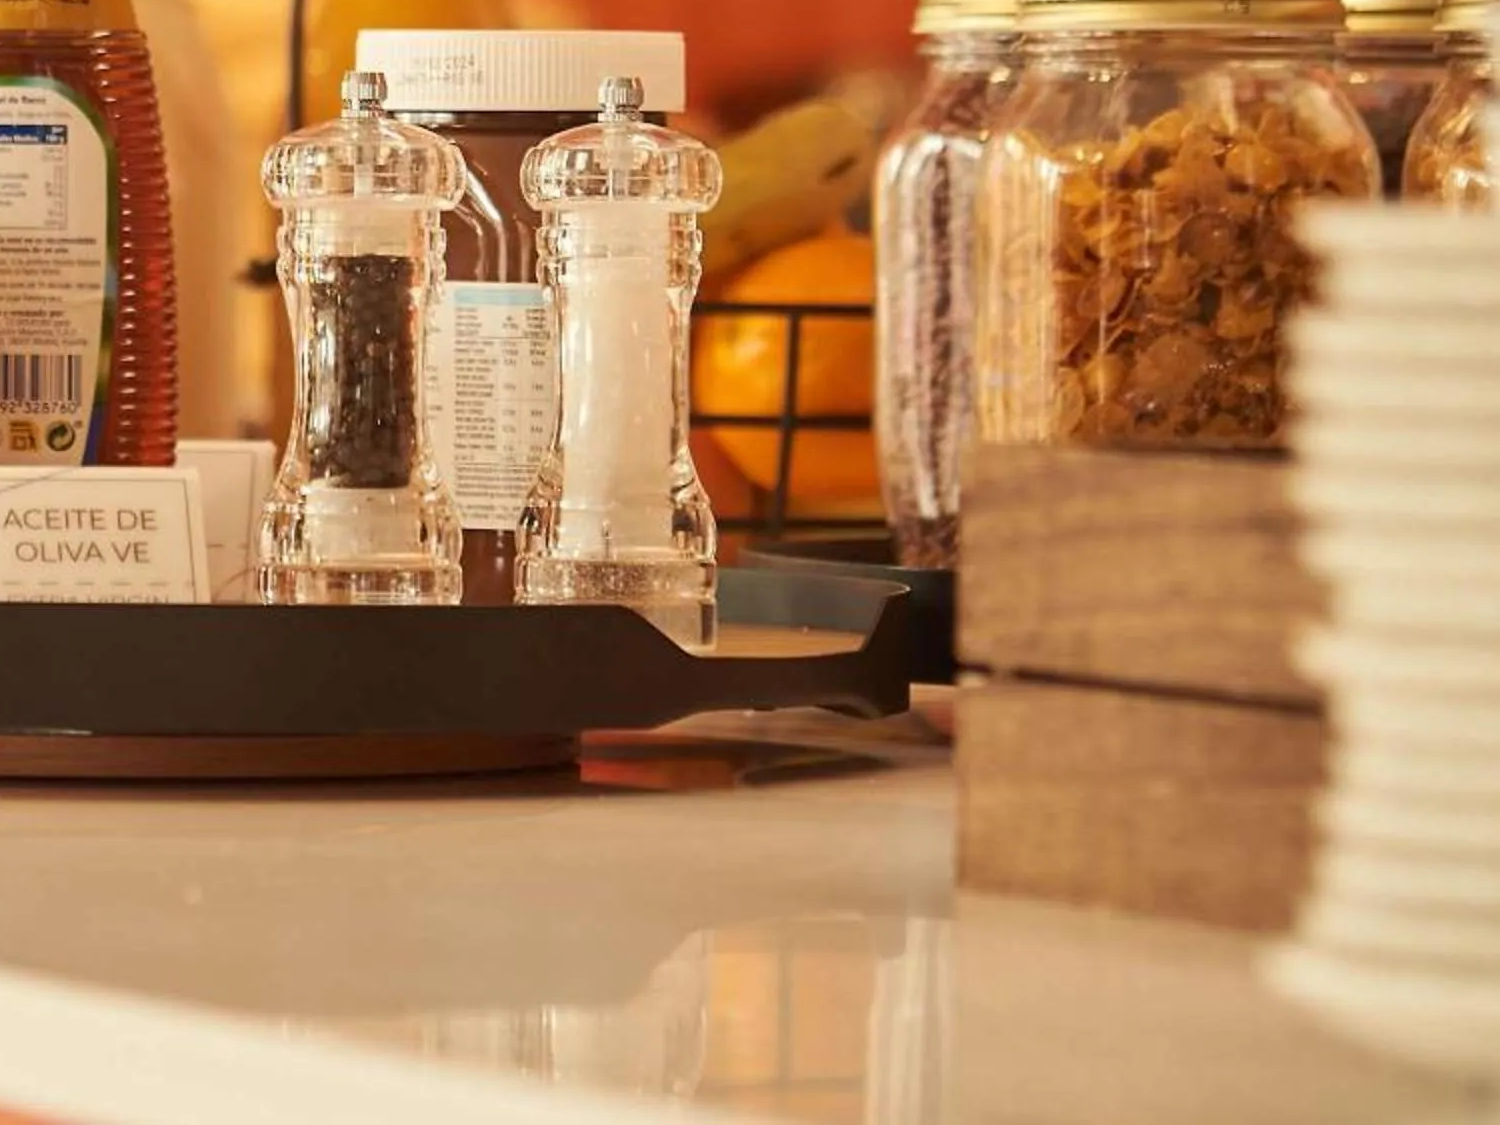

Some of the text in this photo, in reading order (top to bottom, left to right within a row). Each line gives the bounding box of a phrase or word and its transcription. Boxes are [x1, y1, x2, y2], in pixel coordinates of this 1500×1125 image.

[2, 508, 159, 531] ACEITE DE
[14, 541, 150, 564] OLIVA VE
